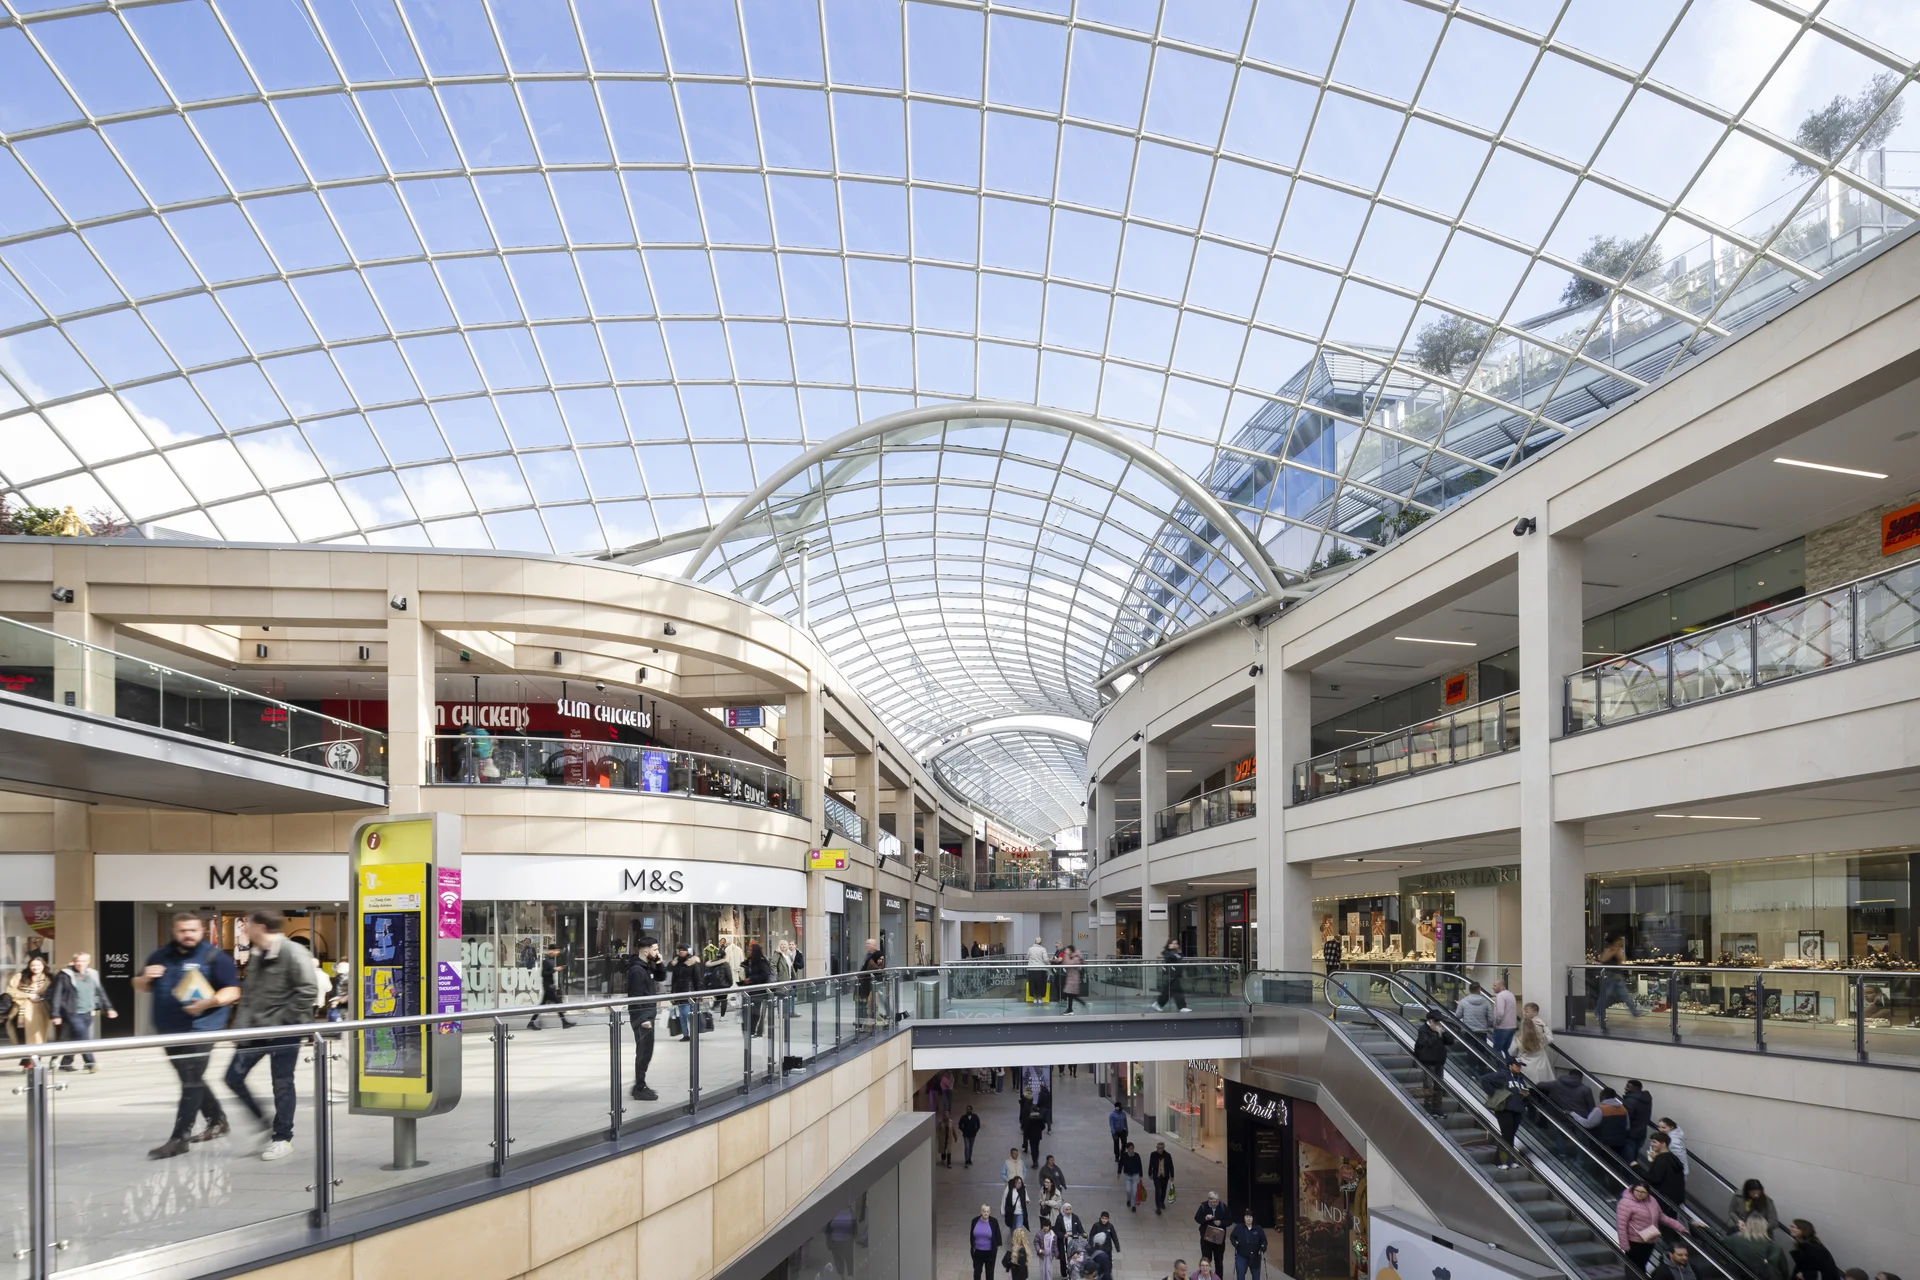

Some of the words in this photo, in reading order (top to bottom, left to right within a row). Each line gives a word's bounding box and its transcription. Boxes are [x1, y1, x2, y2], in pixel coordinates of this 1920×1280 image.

[452, 705, 530, 727] CHICKENS
[557, 698, 590, 719] SLIM
[594, 705, 651, 728] CHICKENS
[209, 866, 278, 889] M&S
[625, 869, 683, 892] M&S
[1474, 867, 1521, 884] HART
[106, 954, 129, 963] M&S
[461, 967, 541, 992] AUTUM
[1240, 1092, 1276, 1120] Lindt
[1315, 1199, 1361, 1232] LINDR
